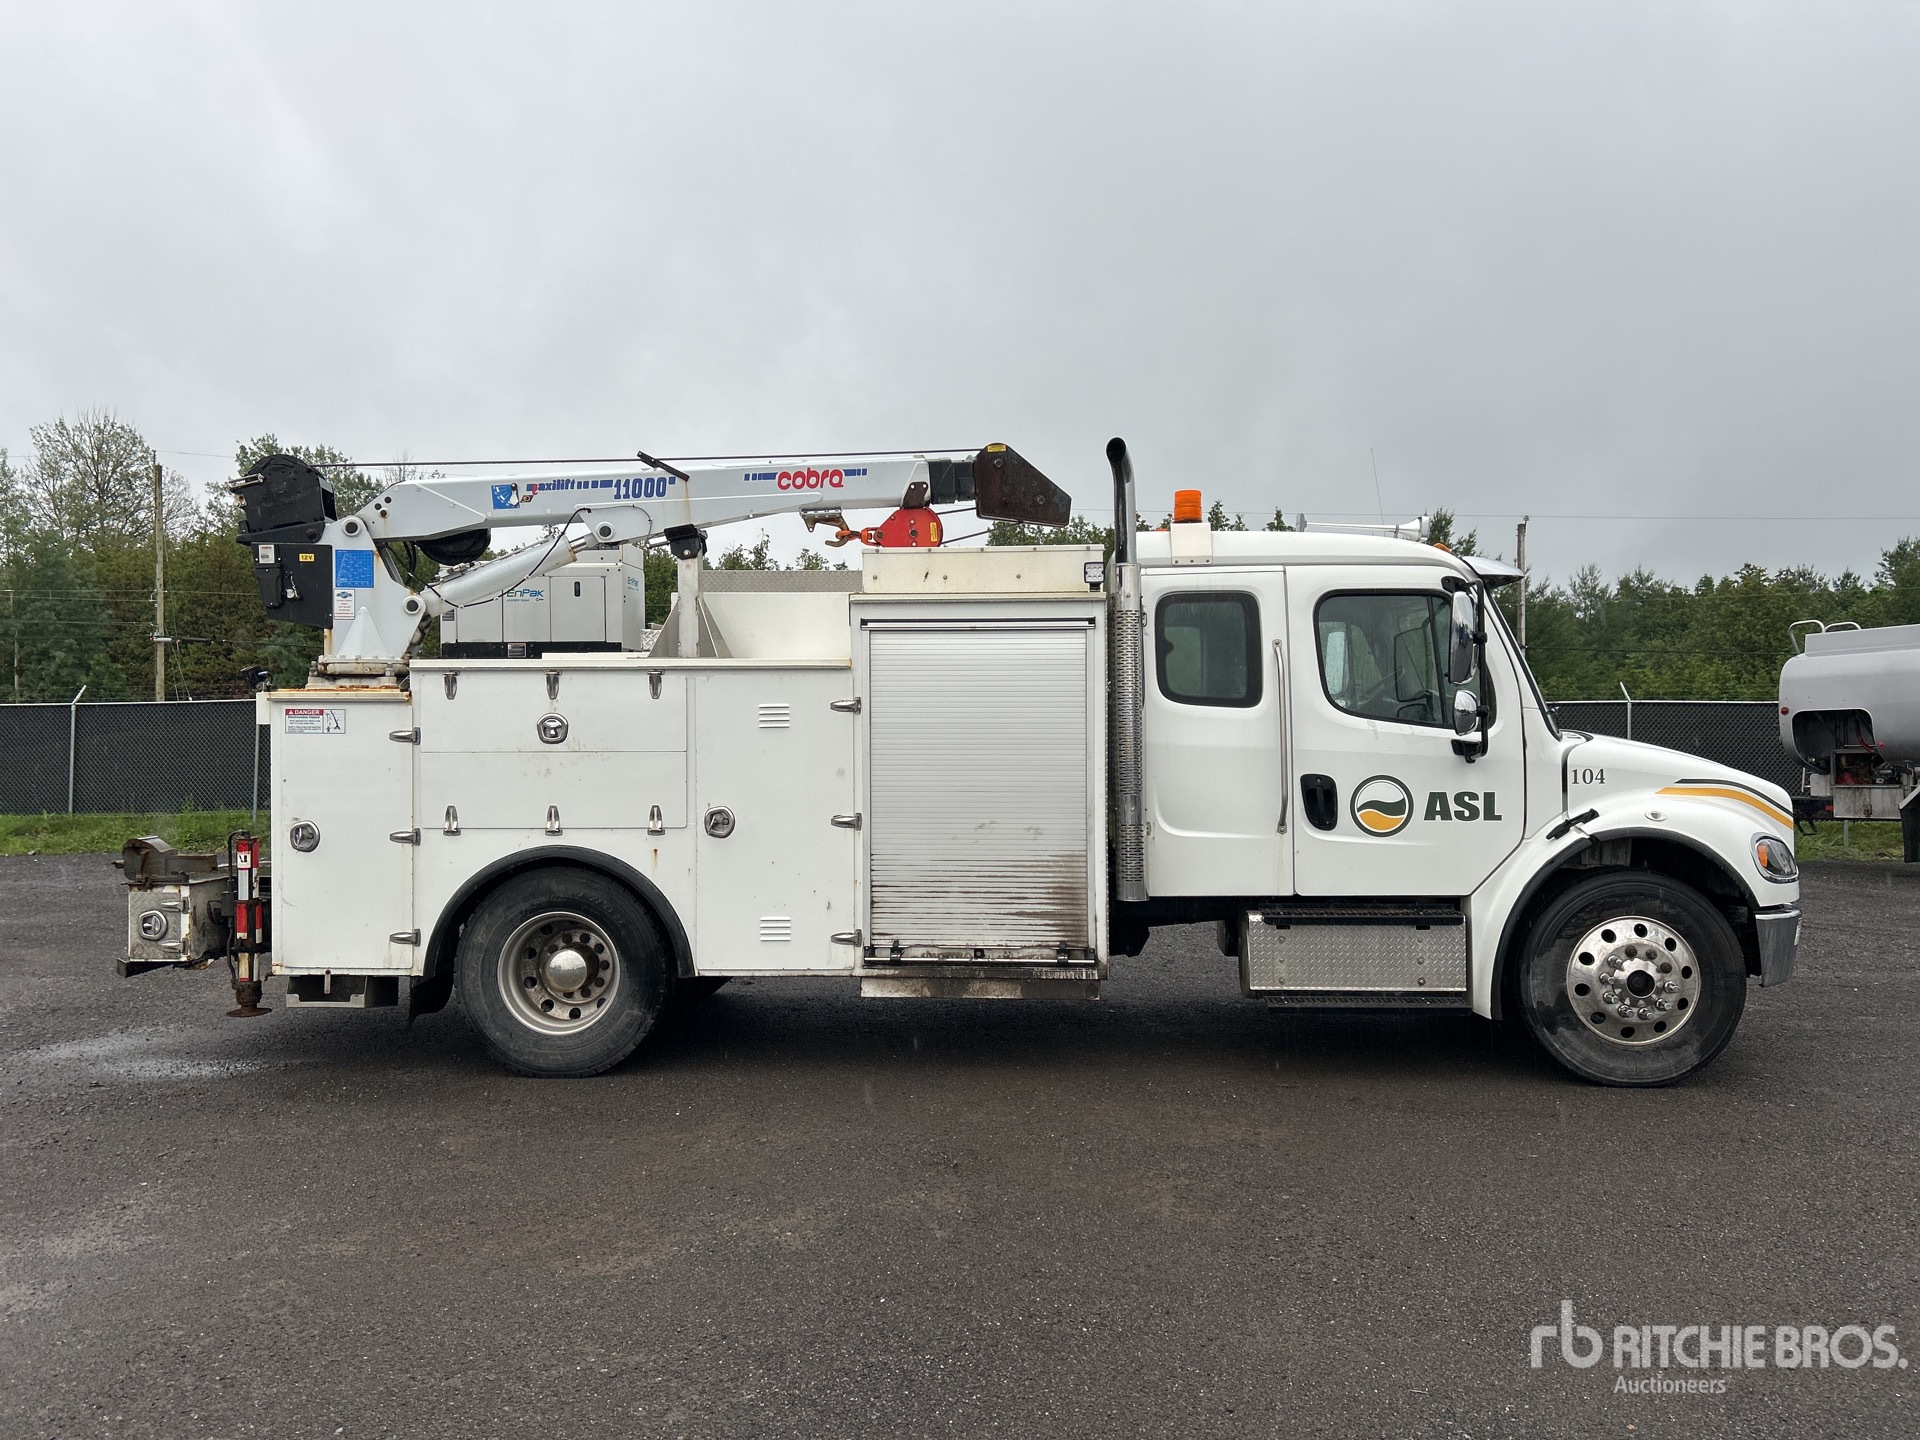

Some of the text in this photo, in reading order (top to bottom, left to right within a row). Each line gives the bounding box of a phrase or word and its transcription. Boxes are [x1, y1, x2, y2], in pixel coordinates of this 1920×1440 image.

[614, 477, 667, 499] 11000
[777, 467, 844, 490] cobra
[507, 588, 545, 598] EnPak
[1571, 768, 1606, 785] 104
[1423, 791, 1503, 822] ASL
